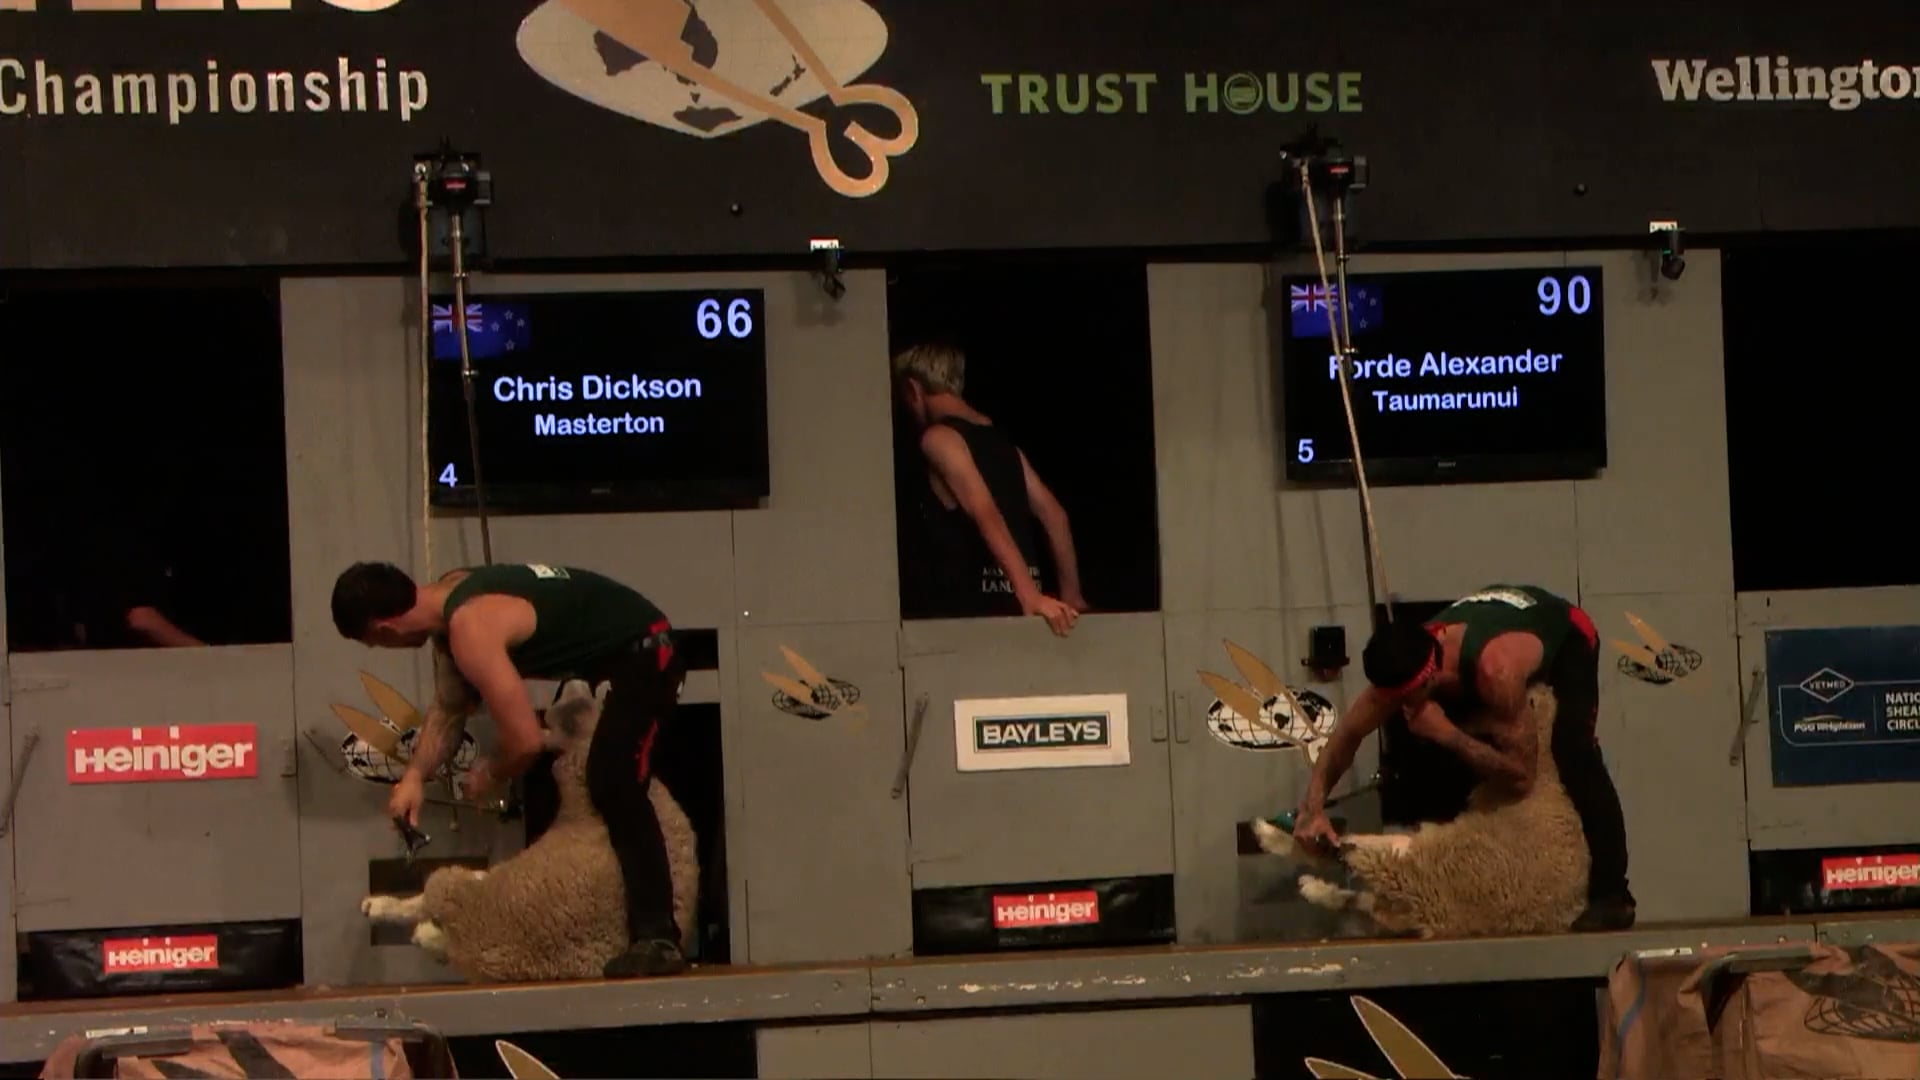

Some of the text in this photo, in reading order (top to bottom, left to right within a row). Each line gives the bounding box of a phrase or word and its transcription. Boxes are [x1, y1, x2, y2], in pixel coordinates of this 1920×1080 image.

[0, 57, 428, 124] Championship
[981, 72, 1362, 114] TRUST HOUSE
[1651, 55, 1920, 111] Wellingto
[1537, 275, 1591, 316] 90
[696, 298, 753, 339] 66
[1419, 349, 1563, 376] Alexander
[494, 374, 702, 402] Chris Dickson
[1372, 386, 1518, 413] Taumarunui
[534, 411, 665, 436] Masterton
[1297, 438, 1315, 463] 5
[439, 462, 458, 488] 4
[1886, 705, 1920, 718] SHEA
[982, 721, 1101, 745] BAYLEYS
[73, 725, 253, 777] Heiniger
[1826, 857, 1920, 885] Heiniger
[997, 894, 1096, 925] Heiniger
[107, 937, 215, 969] Heiniger
